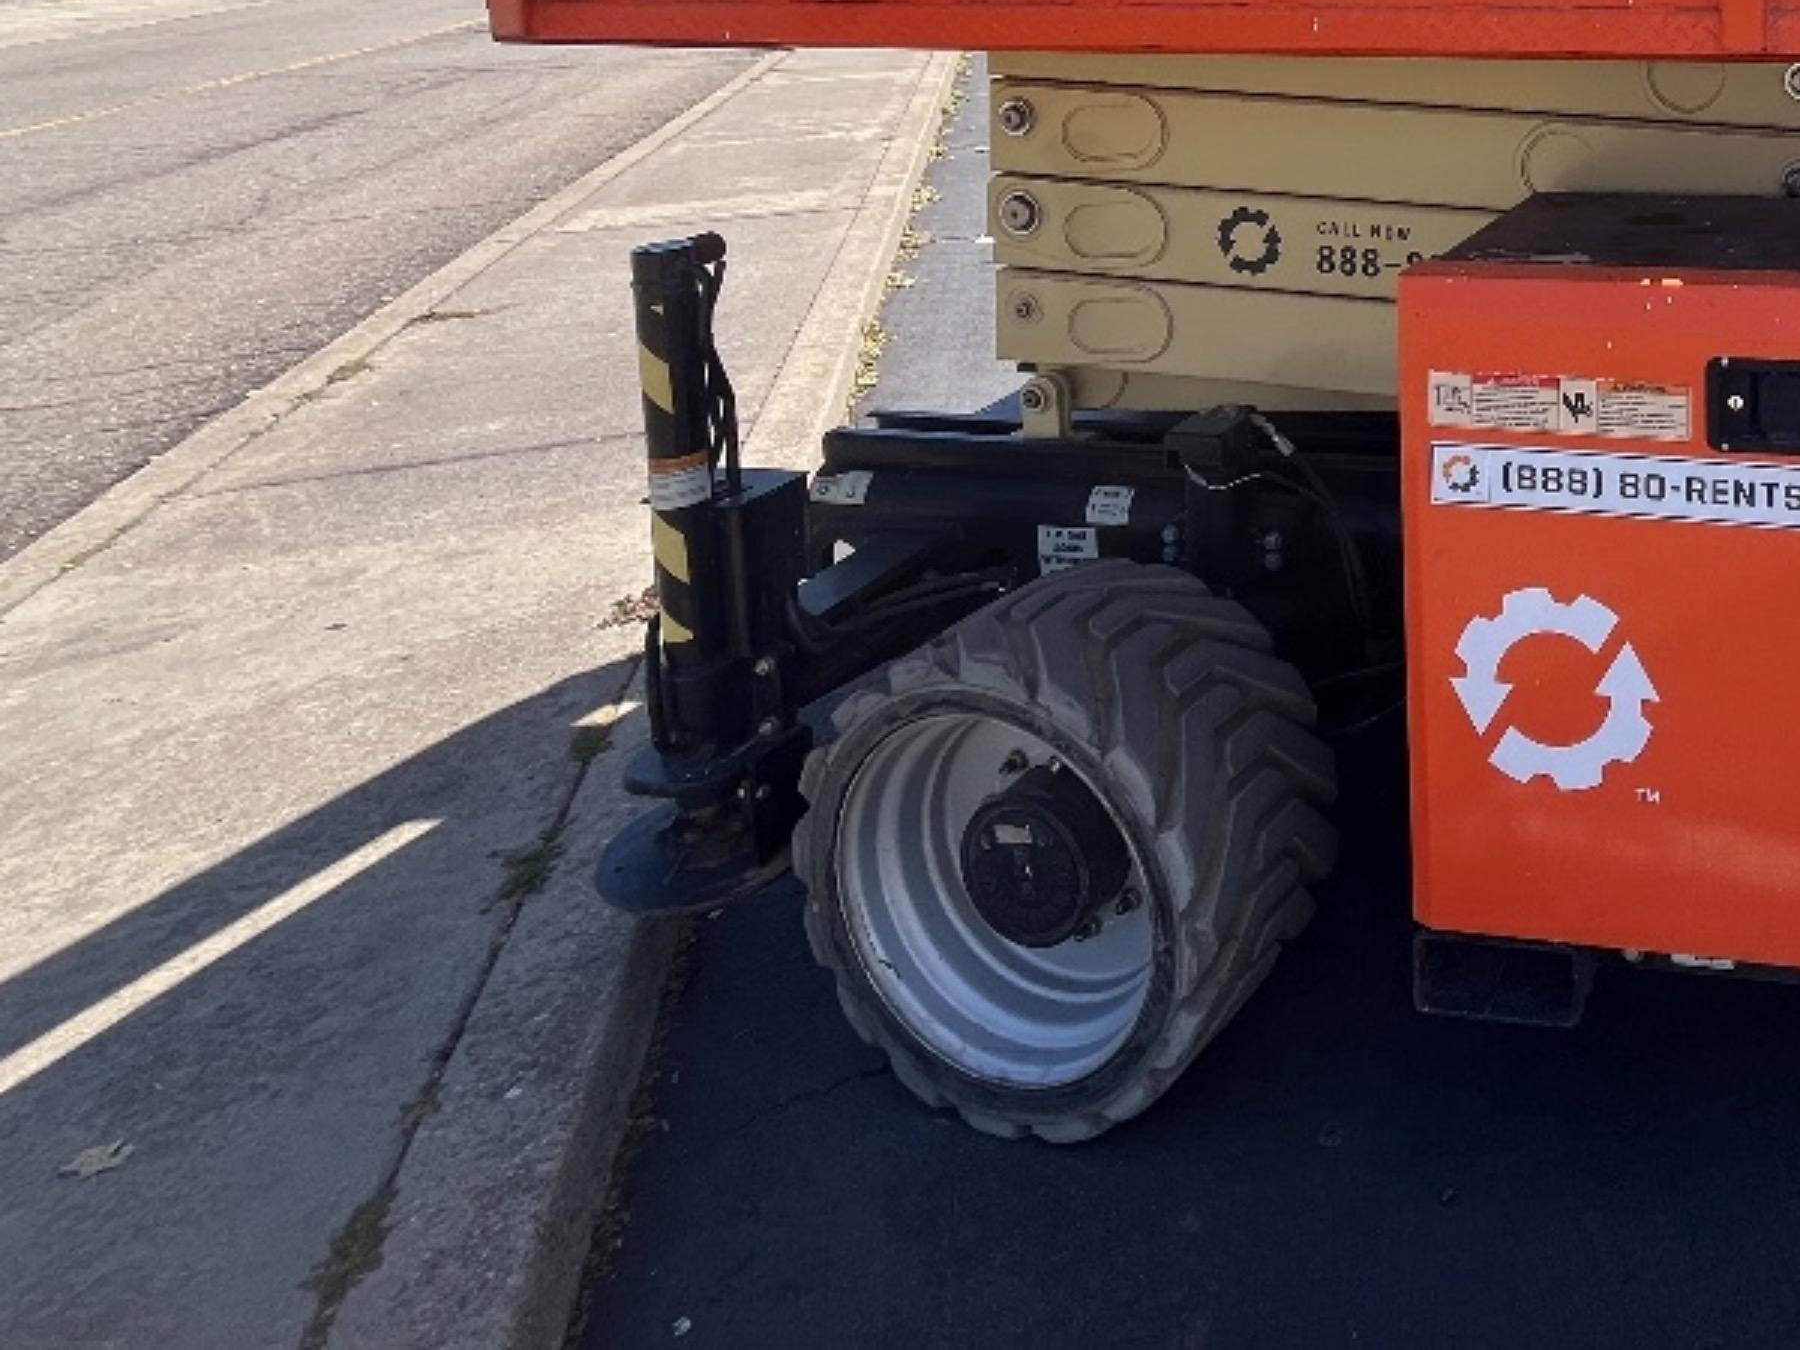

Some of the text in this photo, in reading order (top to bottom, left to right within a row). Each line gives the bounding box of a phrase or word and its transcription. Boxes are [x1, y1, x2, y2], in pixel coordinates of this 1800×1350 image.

[1316, 221, 1411, 241] CALL NOW
[1502, 461, 1603, 499] (888)
